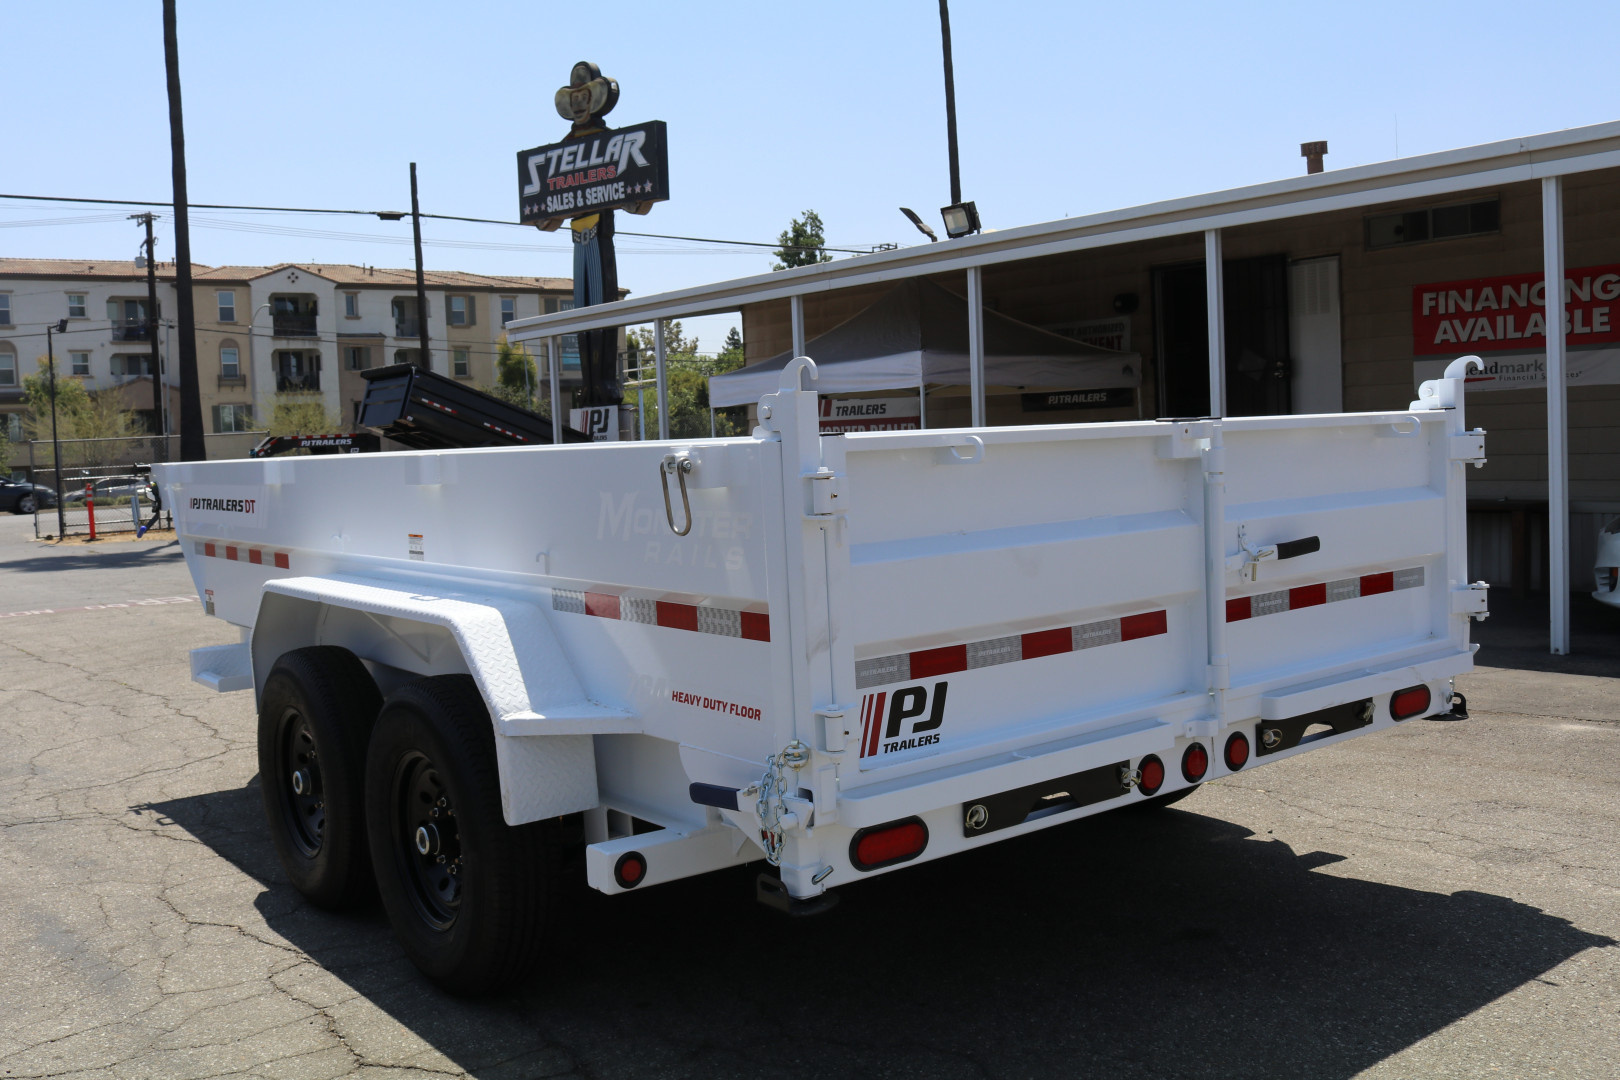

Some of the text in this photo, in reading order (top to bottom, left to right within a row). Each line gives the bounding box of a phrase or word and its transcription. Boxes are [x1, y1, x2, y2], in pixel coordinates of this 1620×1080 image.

[523, 130, 650, 197] STELLAR
[547, 165, 617, 191] TRAILERS
[546, 181, 626, 213] SALES & SERVICE
[1422, 273, 1620, 316] FINANCNG
[1465, 359, 1544, 376] endmark
[1499, 373, 1537, 382] Financial
[589, 408, 610, 437] PJ
[835, 403, 887, 417] TRAILERS
[671, 690, 762, 721] HEAVY DUTY FLOOR
[885, 681, 949, 739] PJ
[883, 733, 941, 754] TRAILERS
